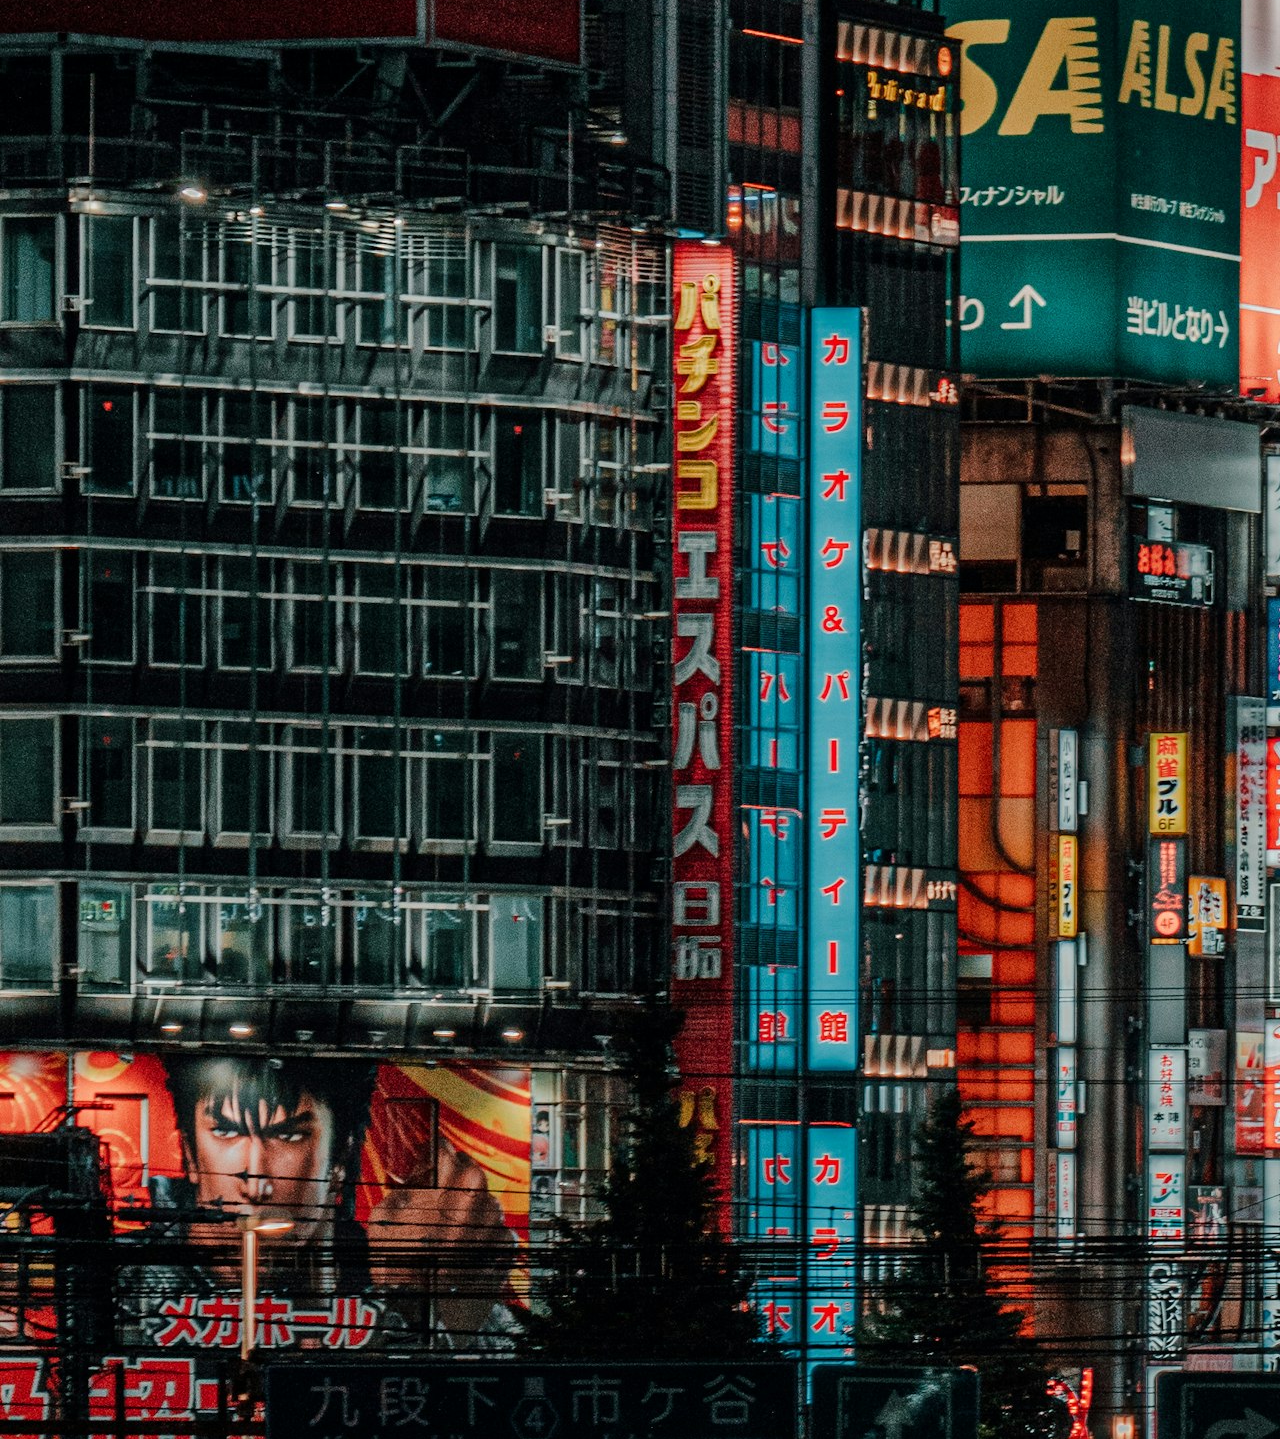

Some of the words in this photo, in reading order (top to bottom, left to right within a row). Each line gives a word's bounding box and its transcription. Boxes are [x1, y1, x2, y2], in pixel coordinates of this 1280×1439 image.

[1118, 19, 1238, 127] ALSA
[1126, 295, 1214, 345] 当ビルとなり
[819, 334, 850, 1045] カラオケ&パーティー館
[1156, 735, 1179, 816] 麻雀ブル
[1158, 818, 1176, 830] 6F
[1160, 1053, 1174, 1107] お好み焼
[154, 1296, 378, 1349] メガホール
[309, 1374, 497, 1430] 九段下
